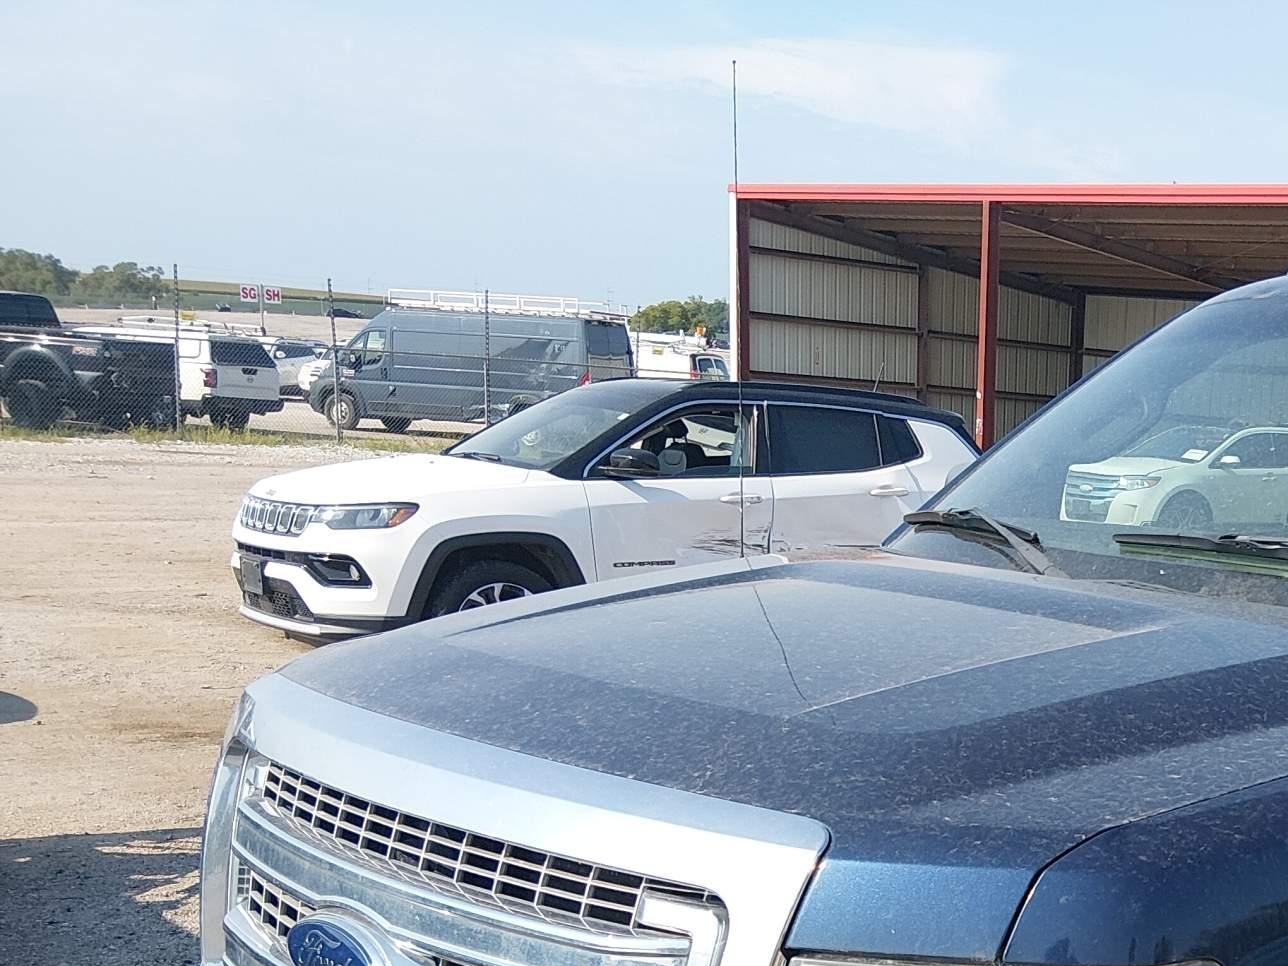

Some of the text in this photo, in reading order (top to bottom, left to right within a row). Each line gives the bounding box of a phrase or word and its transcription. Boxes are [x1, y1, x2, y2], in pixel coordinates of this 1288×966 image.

[241, 287, 257, 300] SG
[265, 288, 281, 302] SH
[613, 560, 677, 568] COMPASS
